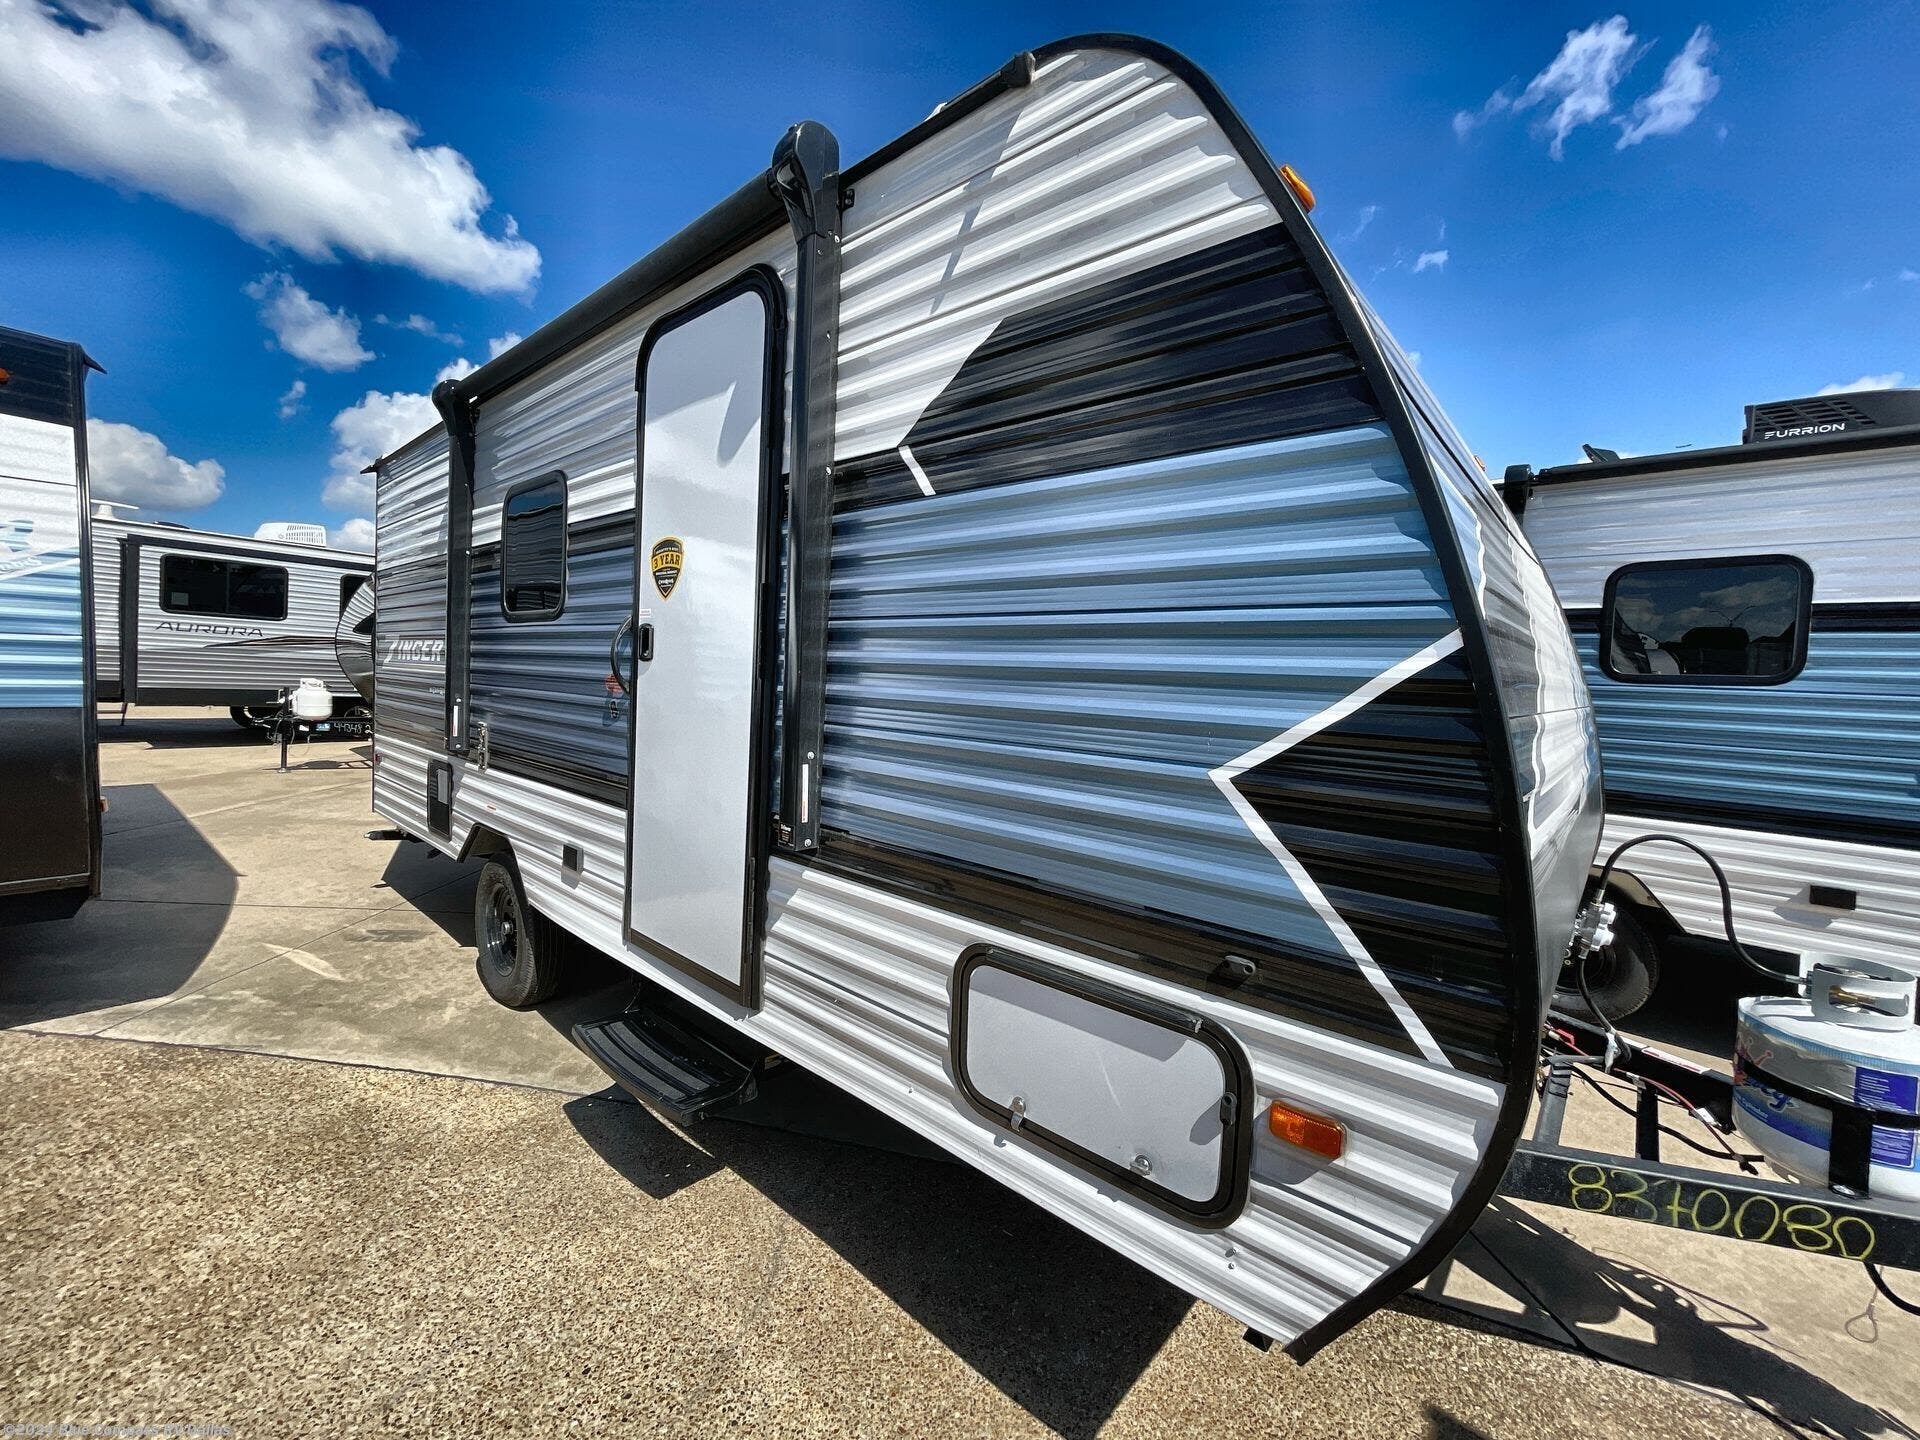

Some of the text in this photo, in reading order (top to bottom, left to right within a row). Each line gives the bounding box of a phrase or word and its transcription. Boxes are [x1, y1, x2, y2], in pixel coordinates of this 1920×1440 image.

[1764, 422, 1846, 440] FURRION
[660, 553, 680, 566] YEAR
[155, 621, 263, 637] AURORA
[383, 636, 445, 664] ZINGER
